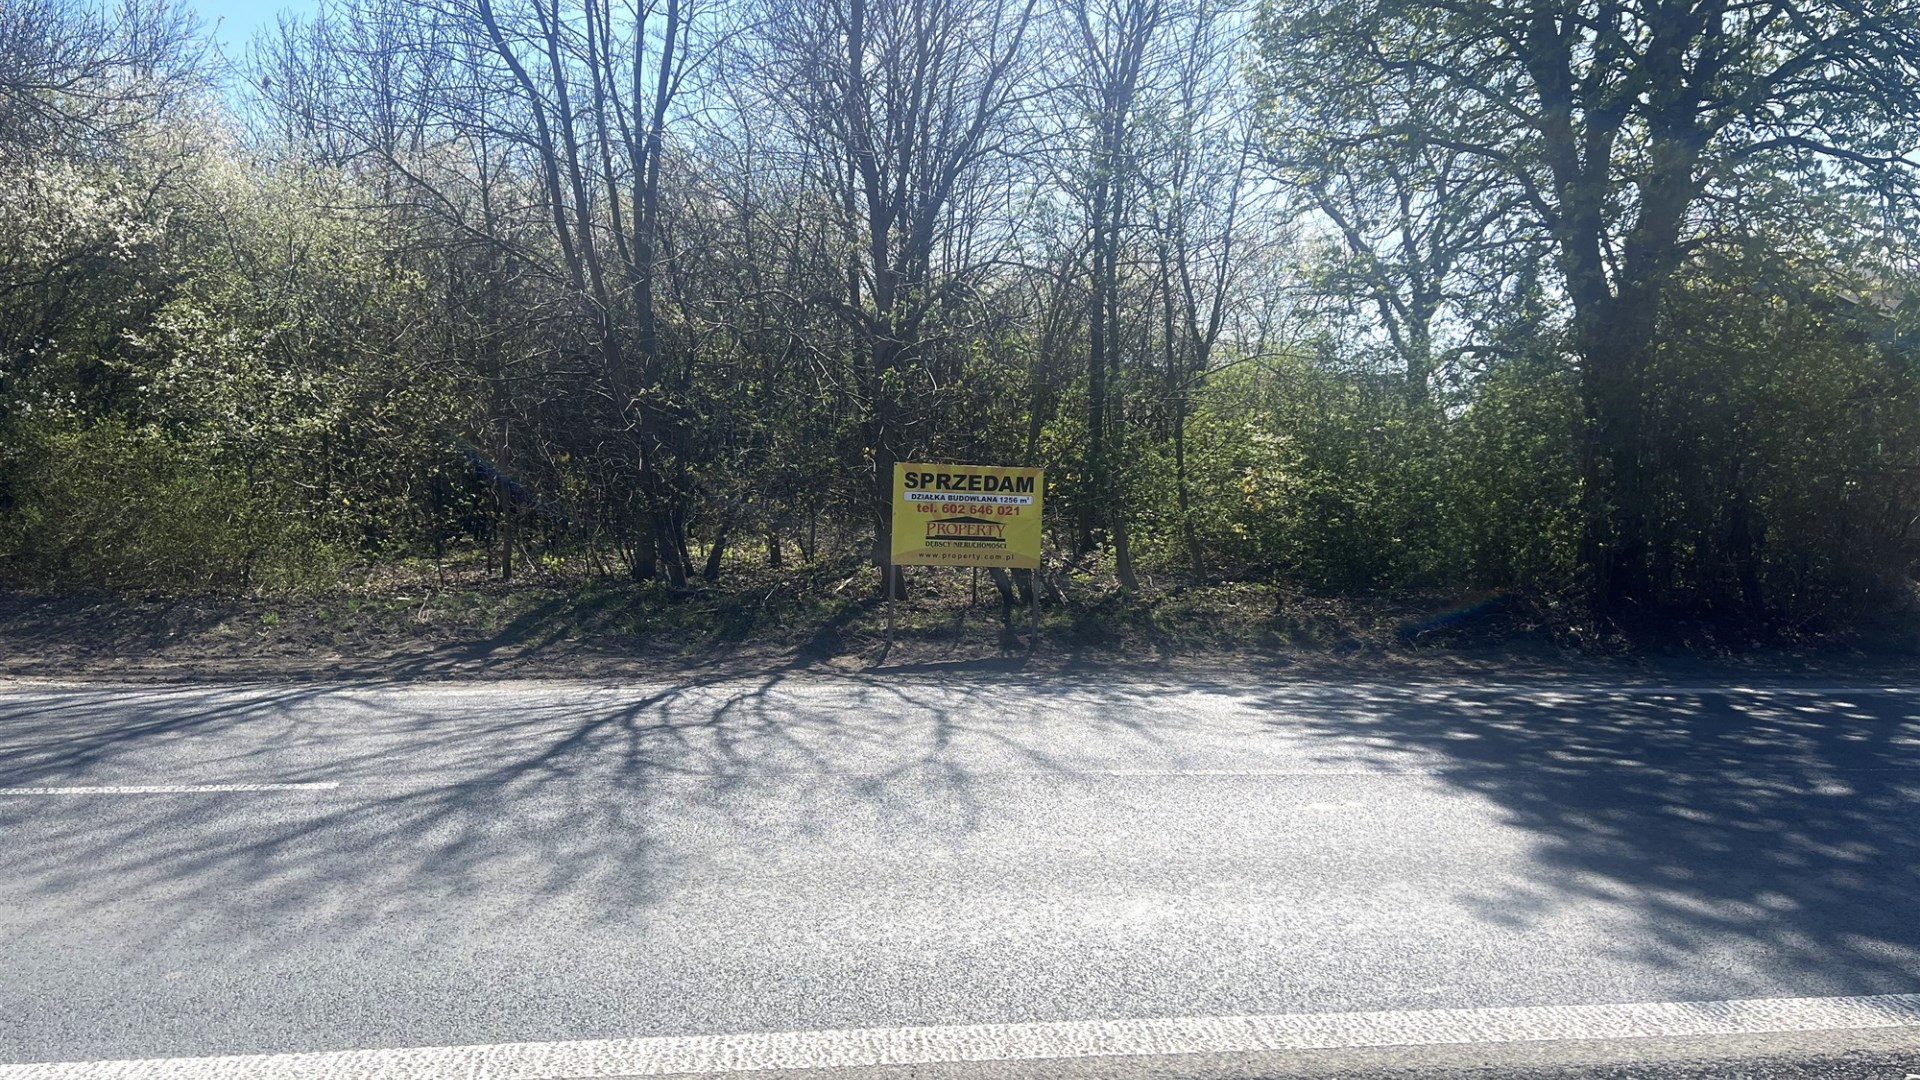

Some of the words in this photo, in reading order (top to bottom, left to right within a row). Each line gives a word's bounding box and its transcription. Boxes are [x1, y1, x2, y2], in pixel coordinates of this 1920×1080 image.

[904, 472, 1034, 493] SPRZEDAM
[911, 493, 946, 501] DZIAŁKA
[947, 495, 998, 503] BUDOWLANA
[917, 503, 937, 513] tel.
[942, 504, 965, 514] 602
[969, 505, 993, 515] 646
[997, 506, 1020, 516] 021
[927, 522, 1006, 538] PROPERTY
